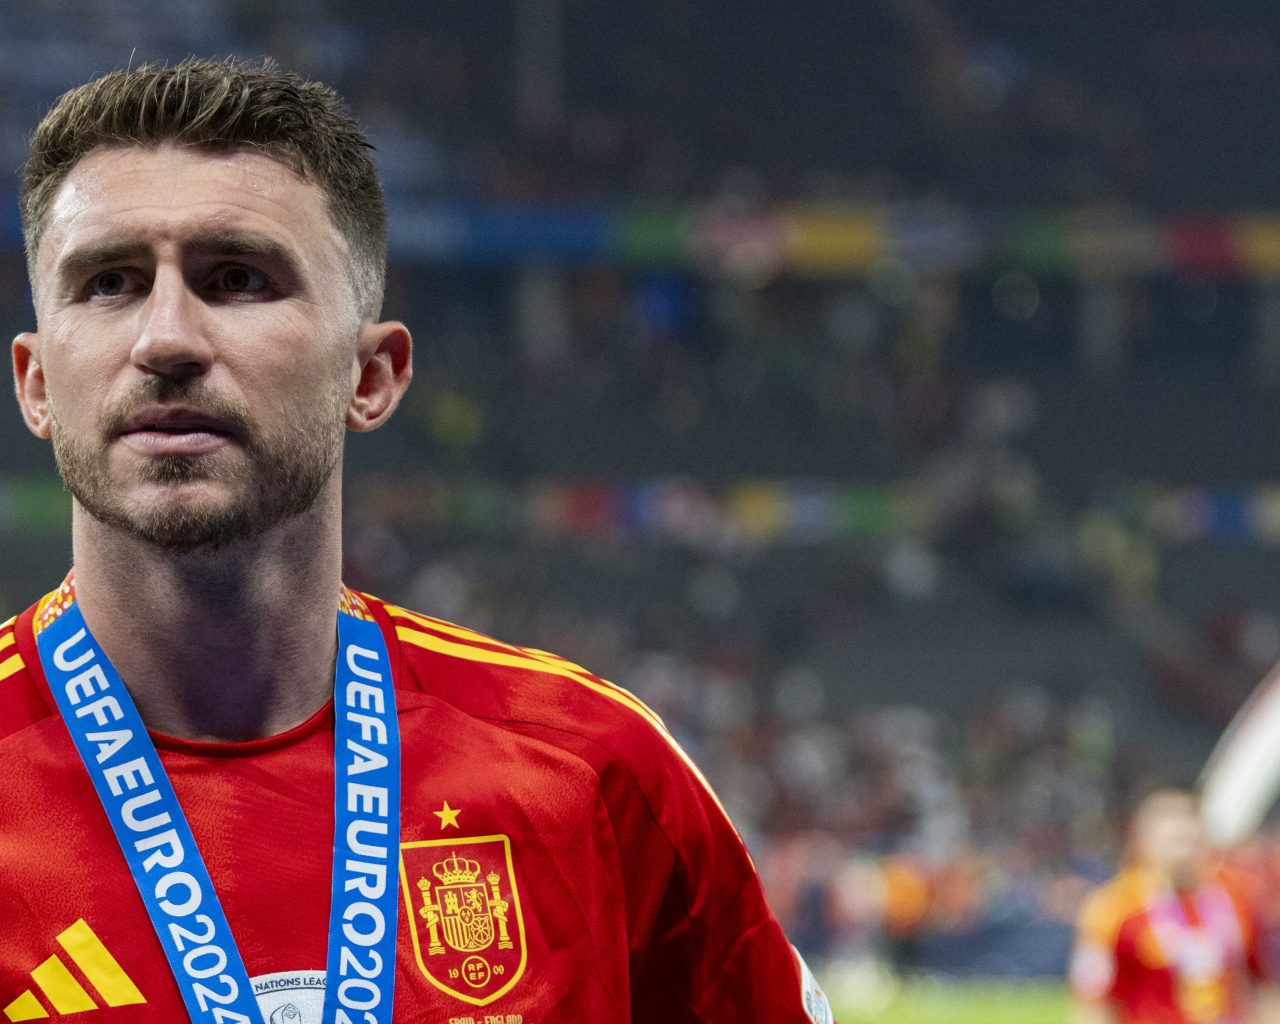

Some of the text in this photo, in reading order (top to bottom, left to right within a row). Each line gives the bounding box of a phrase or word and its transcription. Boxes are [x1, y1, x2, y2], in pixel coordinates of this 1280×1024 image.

[53, 627, 133, 764] UEFA
[346, 644, 388, 775] UEFA
[254, 977, 300, 992] NATIONS
